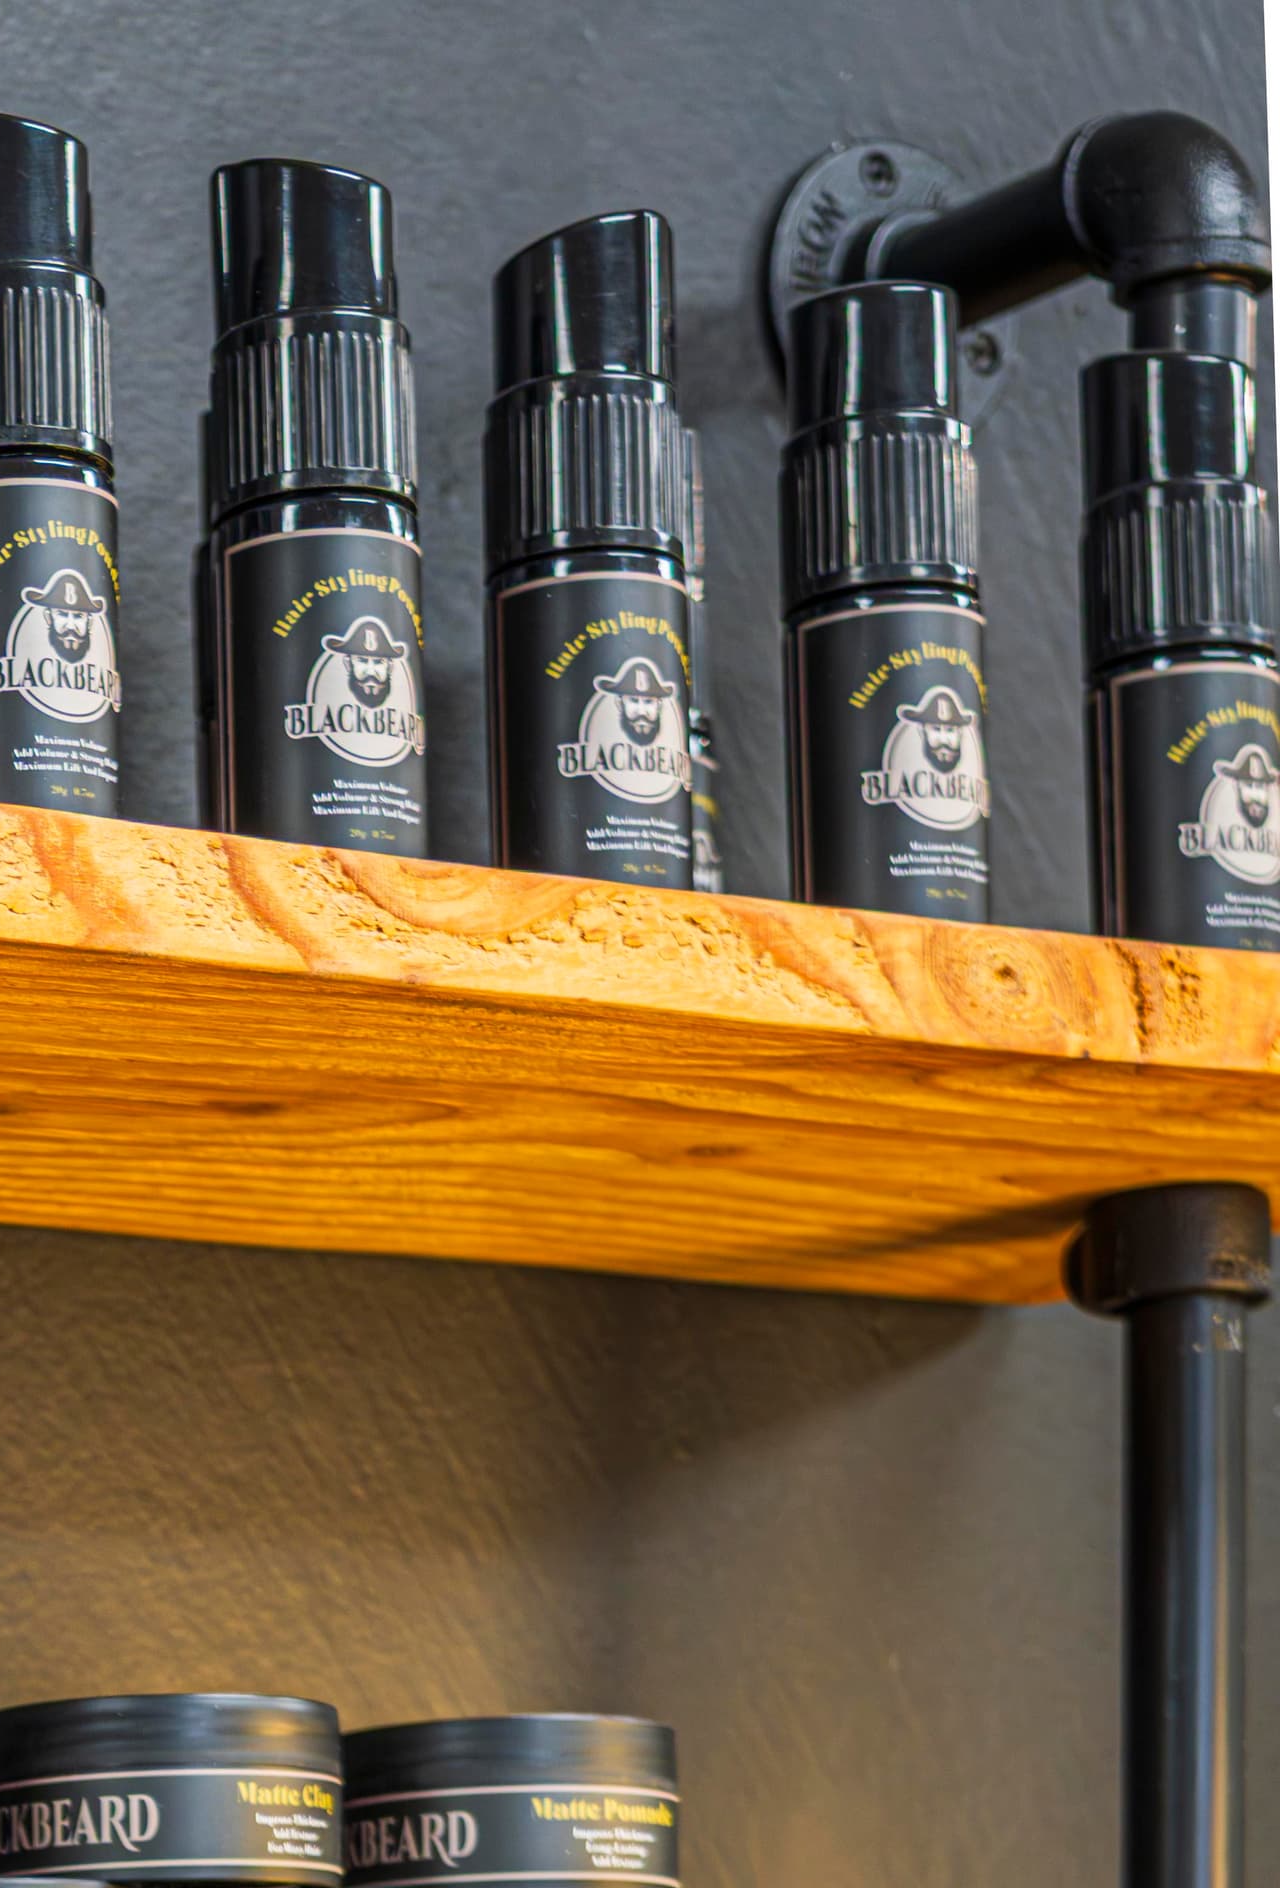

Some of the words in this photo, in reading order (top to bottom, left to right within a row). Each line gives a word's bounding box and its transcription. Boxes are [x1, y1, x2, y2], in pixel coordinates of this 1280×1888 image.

[13, 519, 88, 545] Styling
[272, 591, 314, 638] Hair
[314, 568, 390, 593] Styling
[545, 632, 587, 680] Hair
[586, 611, 659, 636] Styling
